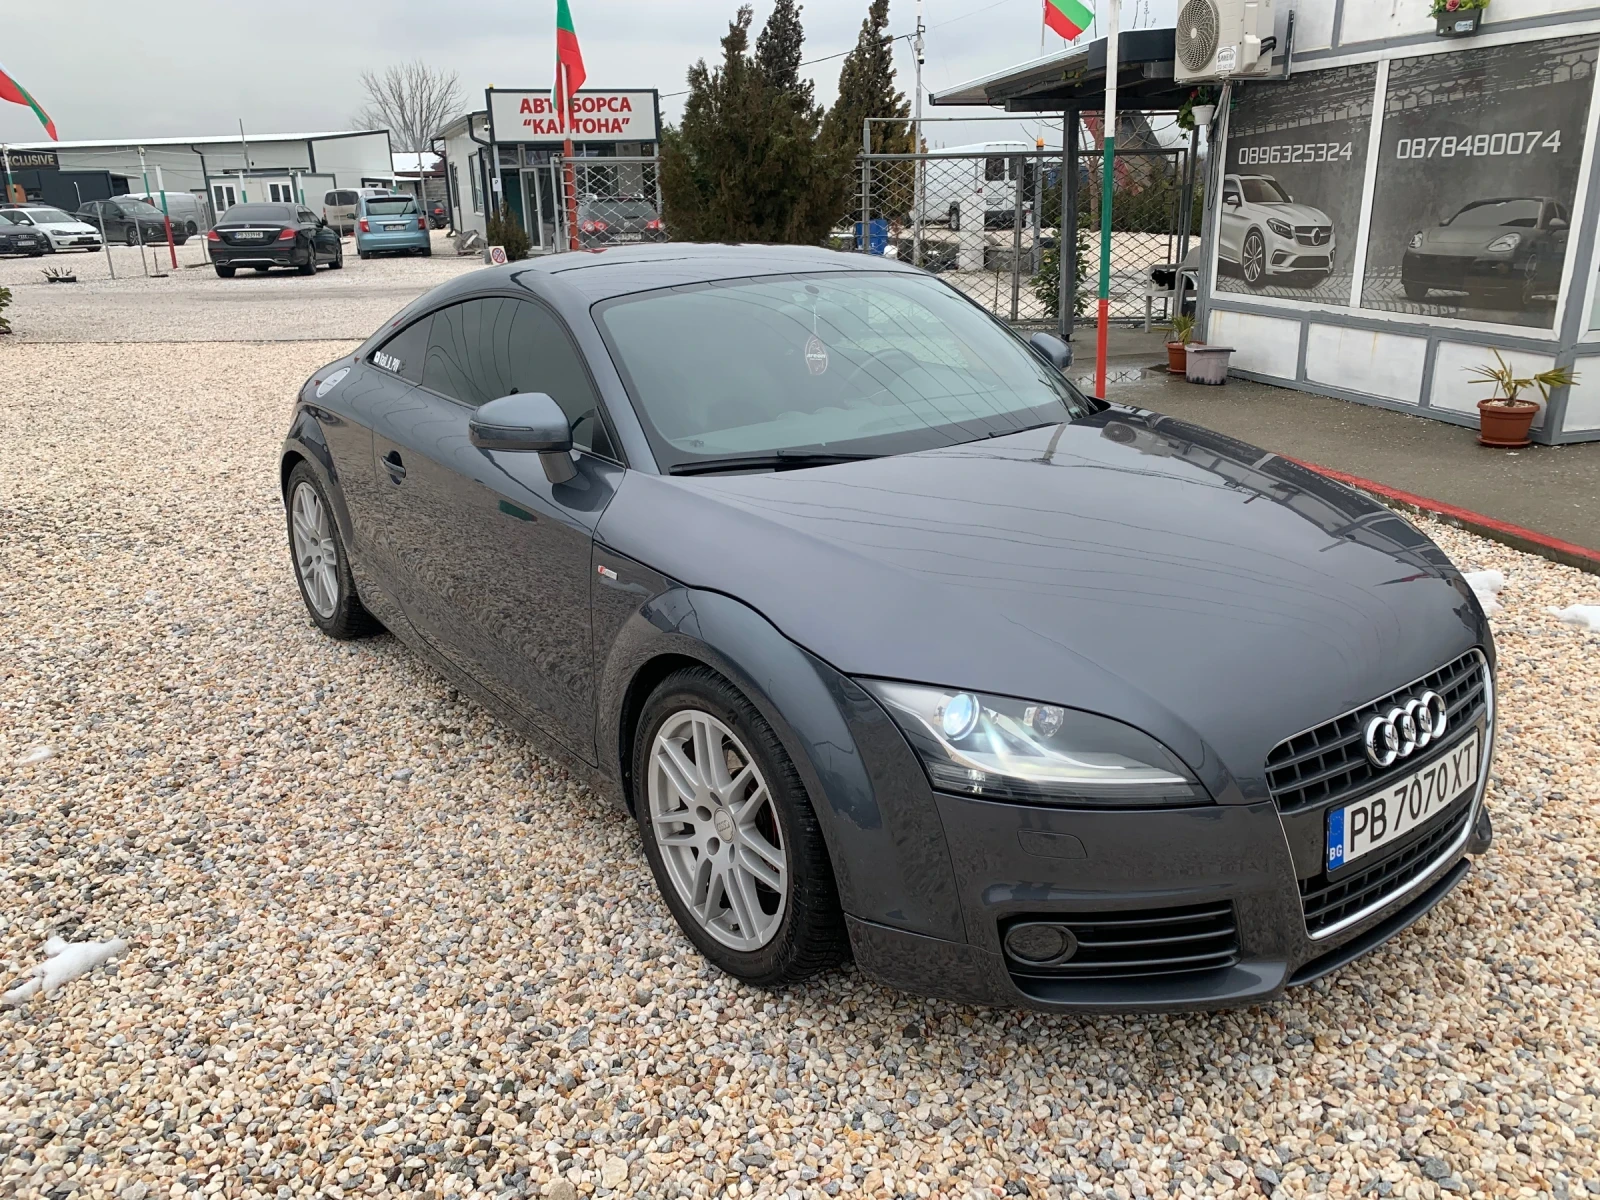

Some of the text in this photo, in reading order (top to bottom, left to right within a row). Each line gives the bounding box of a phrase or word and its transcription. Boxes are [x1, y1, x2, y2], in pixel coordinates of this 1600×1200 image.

[520, 97, 632, 114] АВТБОРСА
[1238, 142, 1353, 165] 0896325324
[1396, 130, 1561, 160] 0878480074
[1350, 740, 1475, 853] PB 7070 XT
[1329, 844, 1343, 861] BG
